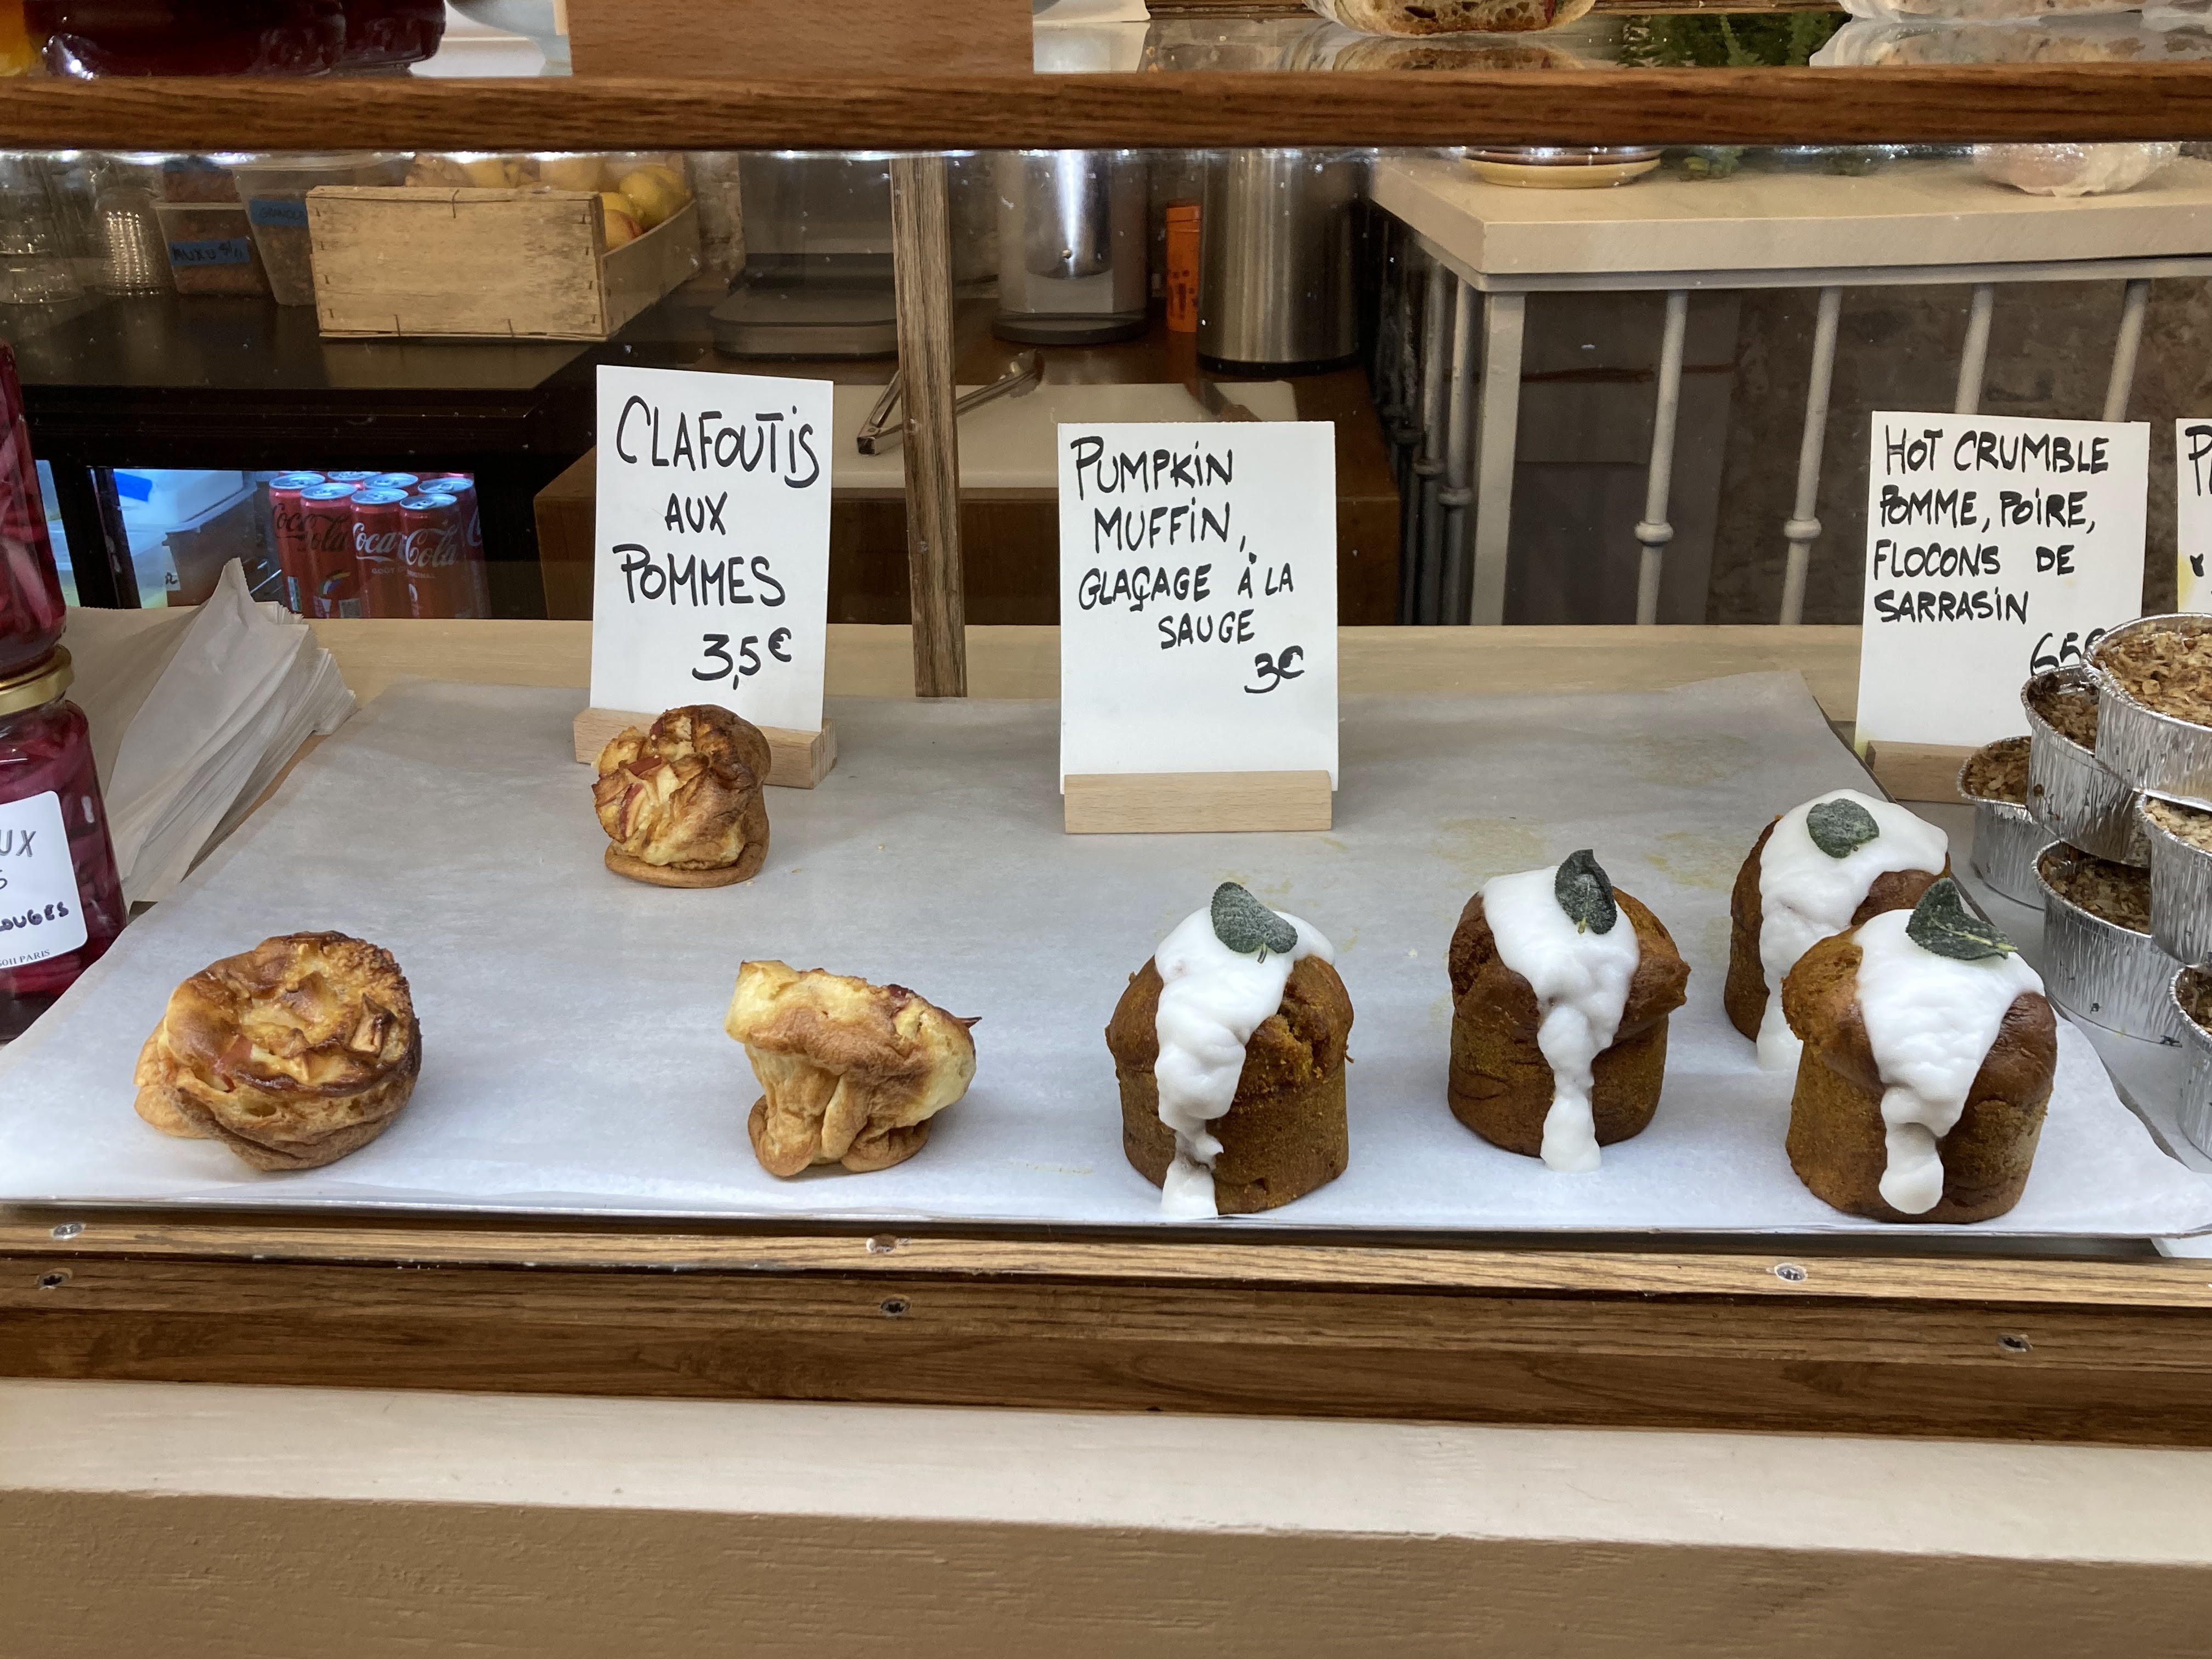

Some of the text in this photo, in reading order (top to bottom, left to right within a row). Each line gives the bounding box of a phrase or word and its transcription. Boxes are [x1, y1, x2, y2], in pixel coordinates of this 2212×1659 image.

[1886, 425, 2109, 475] HOT CRUMBLE
[665, 492, 727, 535] AUX
[1880, 485, 1989, 533] POMME,
[405, 524, 458, 568] Cola
[1874, 539, 2074, 580] FLOCONS DE
[612, 544, 785, 606] POMMES
[1079, 564, 1211, 612] GLAÇAGE
[1265, 563, 1293, 595] LA
[1159, 609, 1254, 650] SAUGE
[692, 628, 791, 690] 3,5€
[0, 901, 69, 931] OUGES
[19, 949, 50, 963] PARIS
